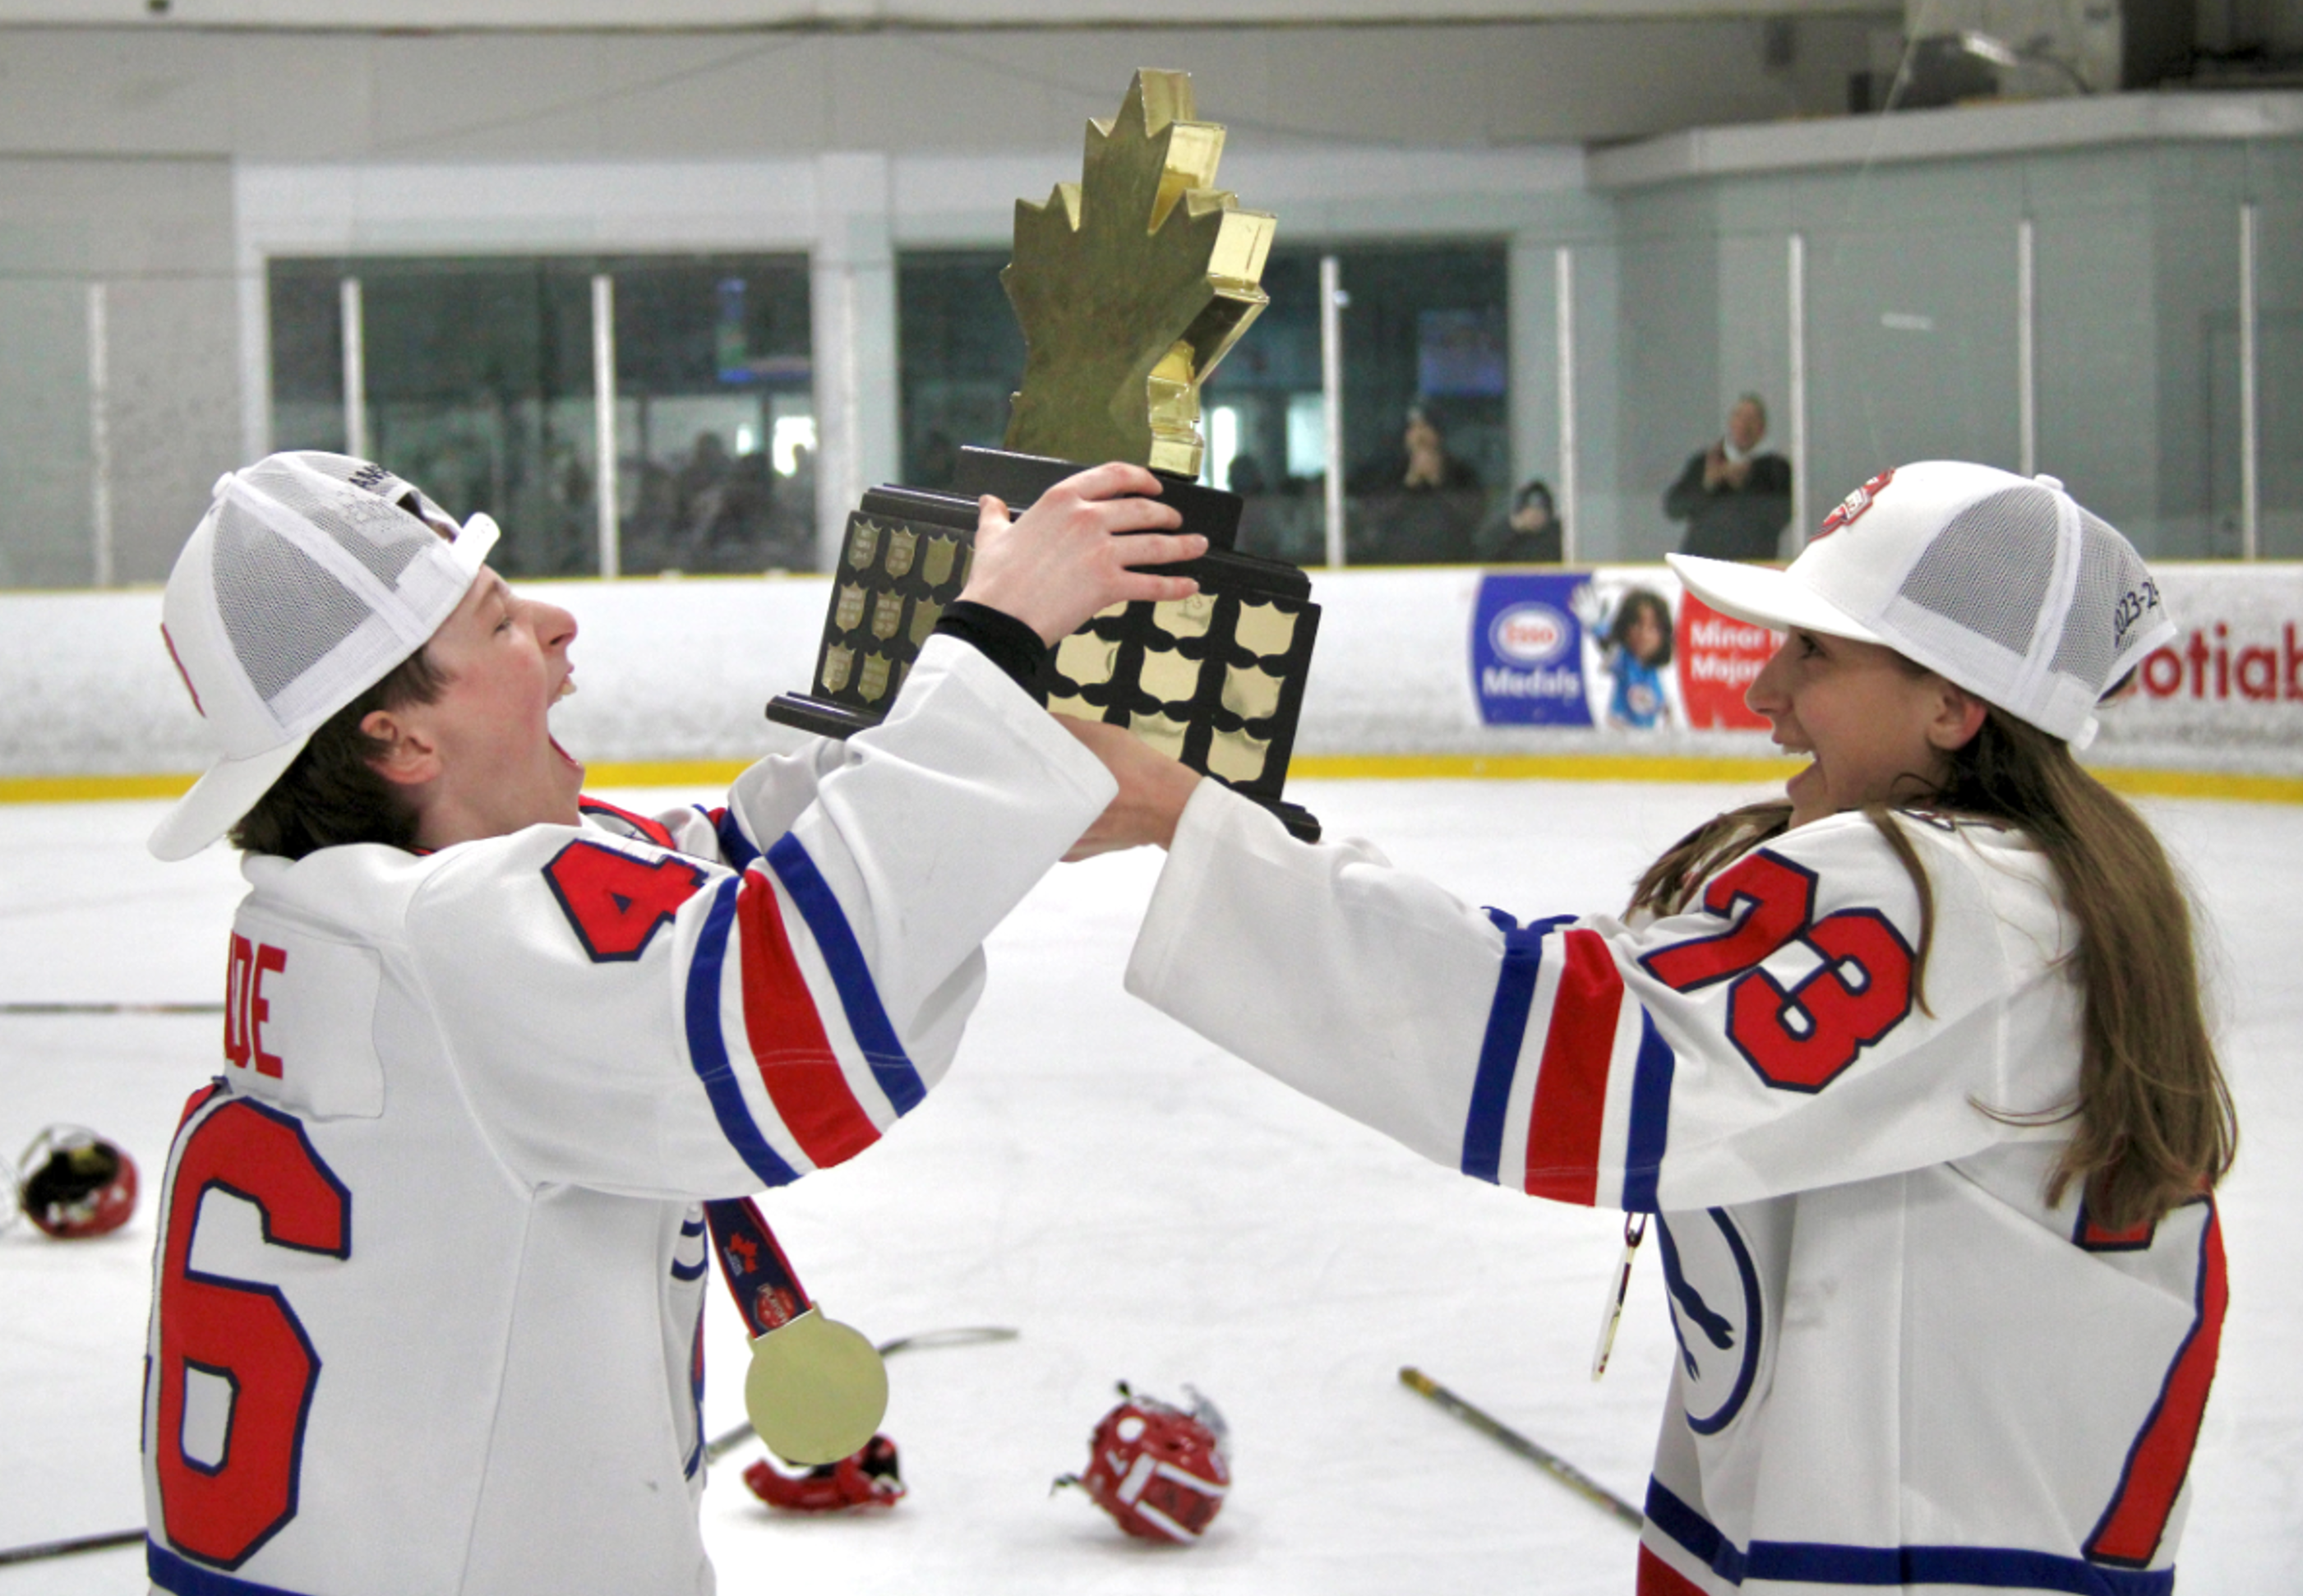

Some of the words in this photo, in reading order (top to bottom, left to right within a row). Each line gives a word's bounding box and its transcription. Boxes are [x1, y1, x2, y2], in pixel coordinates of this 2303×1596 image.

[1506, 623, 1556, 647] Esso
[1691, 620, 1764, 649] Minor
[1691, 653, 1765, 688] Major
[2106, 621, 2303, 703] otiab
[1483, 667, 1580, 700] Medals
[224, 929, 288, 1080] DE
[150, 1089, 352, 1571] 6
